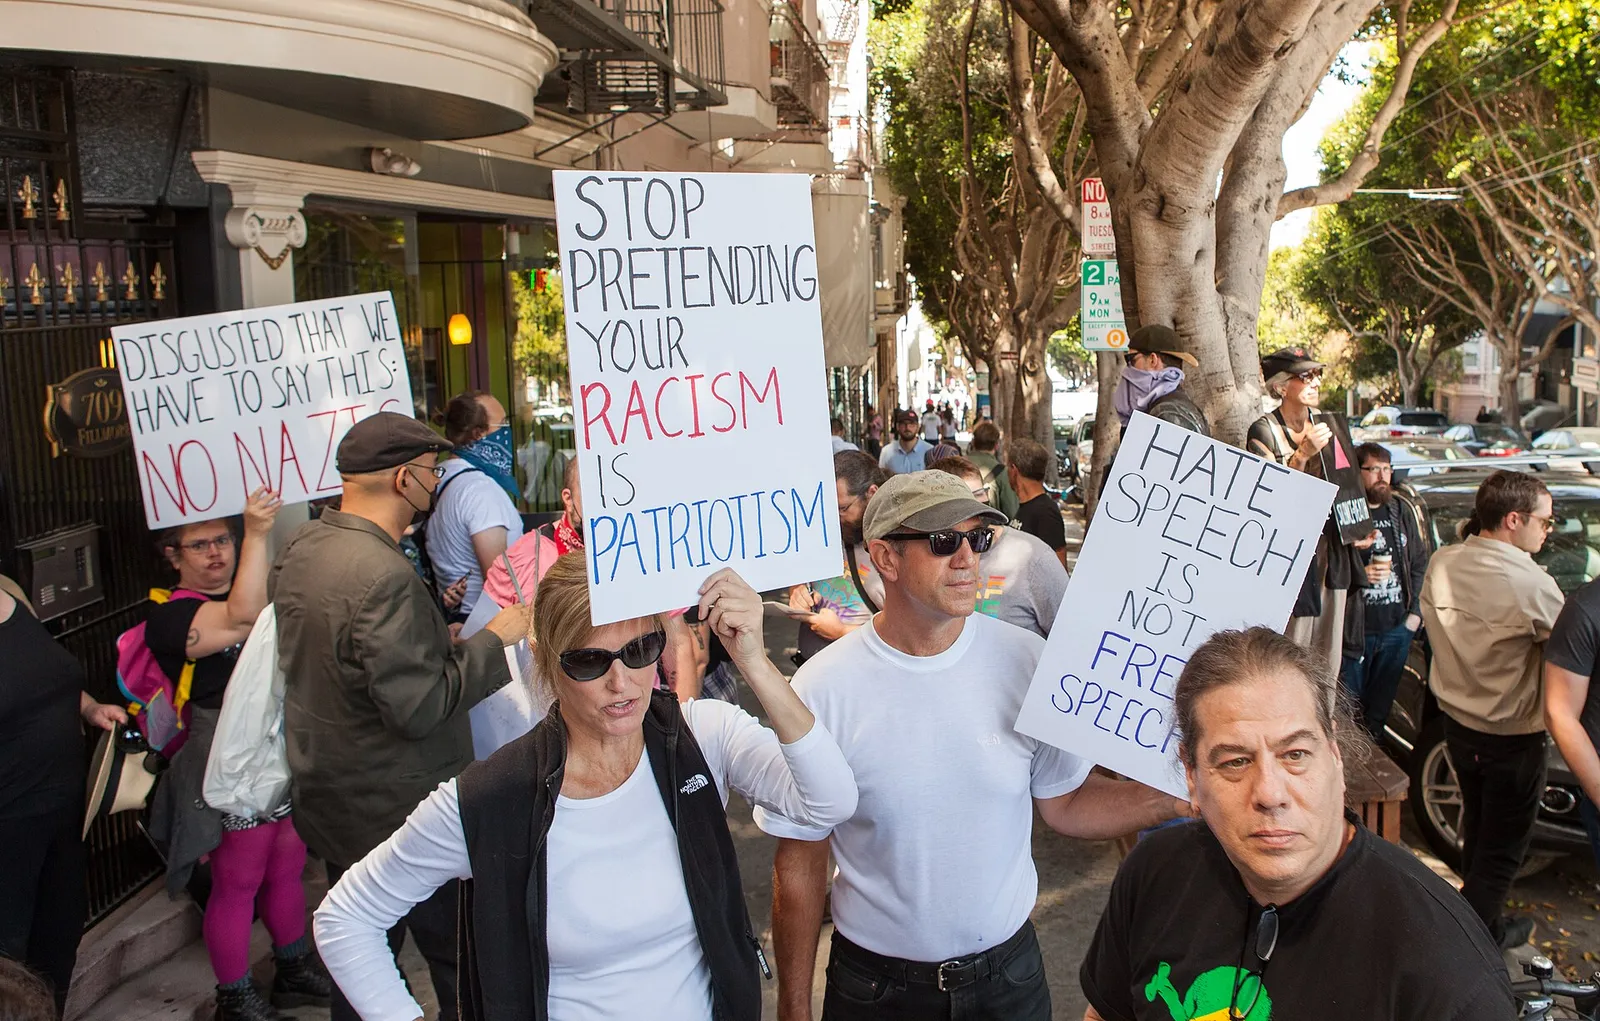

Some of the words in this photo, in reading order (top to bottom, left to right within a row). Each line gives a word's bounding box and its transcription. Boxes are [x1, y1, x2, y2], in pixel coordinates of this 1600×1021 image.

[574, 175, 705, 241] STOP
[1085, 181, 1106, 201] NO
[1090, 205, 1098, 219] 8
[1088, 224, 1114, 237] TUESD
[568, 244, 817, 313] PRETENDING
[1087, 264, 1101, 283] 2
[1089, 292, 1098, 306] 9
[119, 317, 285, 382] DISGUSTED
[288, 306, 348, 354] THAT
[360, 299, 396, 343] WE
[1089, 308, 1110, 318] MON
[575, 315, 690, 374] YOUR
[80, 389, 123, 426] 709
[130, 376, 214, 434] HAVE
[222, 370, 263, 416] TO
[271, 363, 313, 408] SAY
[317, 347, 398, 399] THIS:
[579, 366, 783, 450] RACISM
[141, 439, 218, 522] NO
[233, 398, 401, 501] NAZ
[597, 452, 636, 509] IS
[1139, 423, 1291, 518] HATE
[589, 481, 830, 585] PATRIOTISM
[1105, 472, 1305, 587] SPEECH
[1373, 519, 1392, 528] GAN
[1145, 551, 1200, 605] IS
[1117, 589, 1208, 648] NOT
[1090, 630, 1188, 701] FRE
